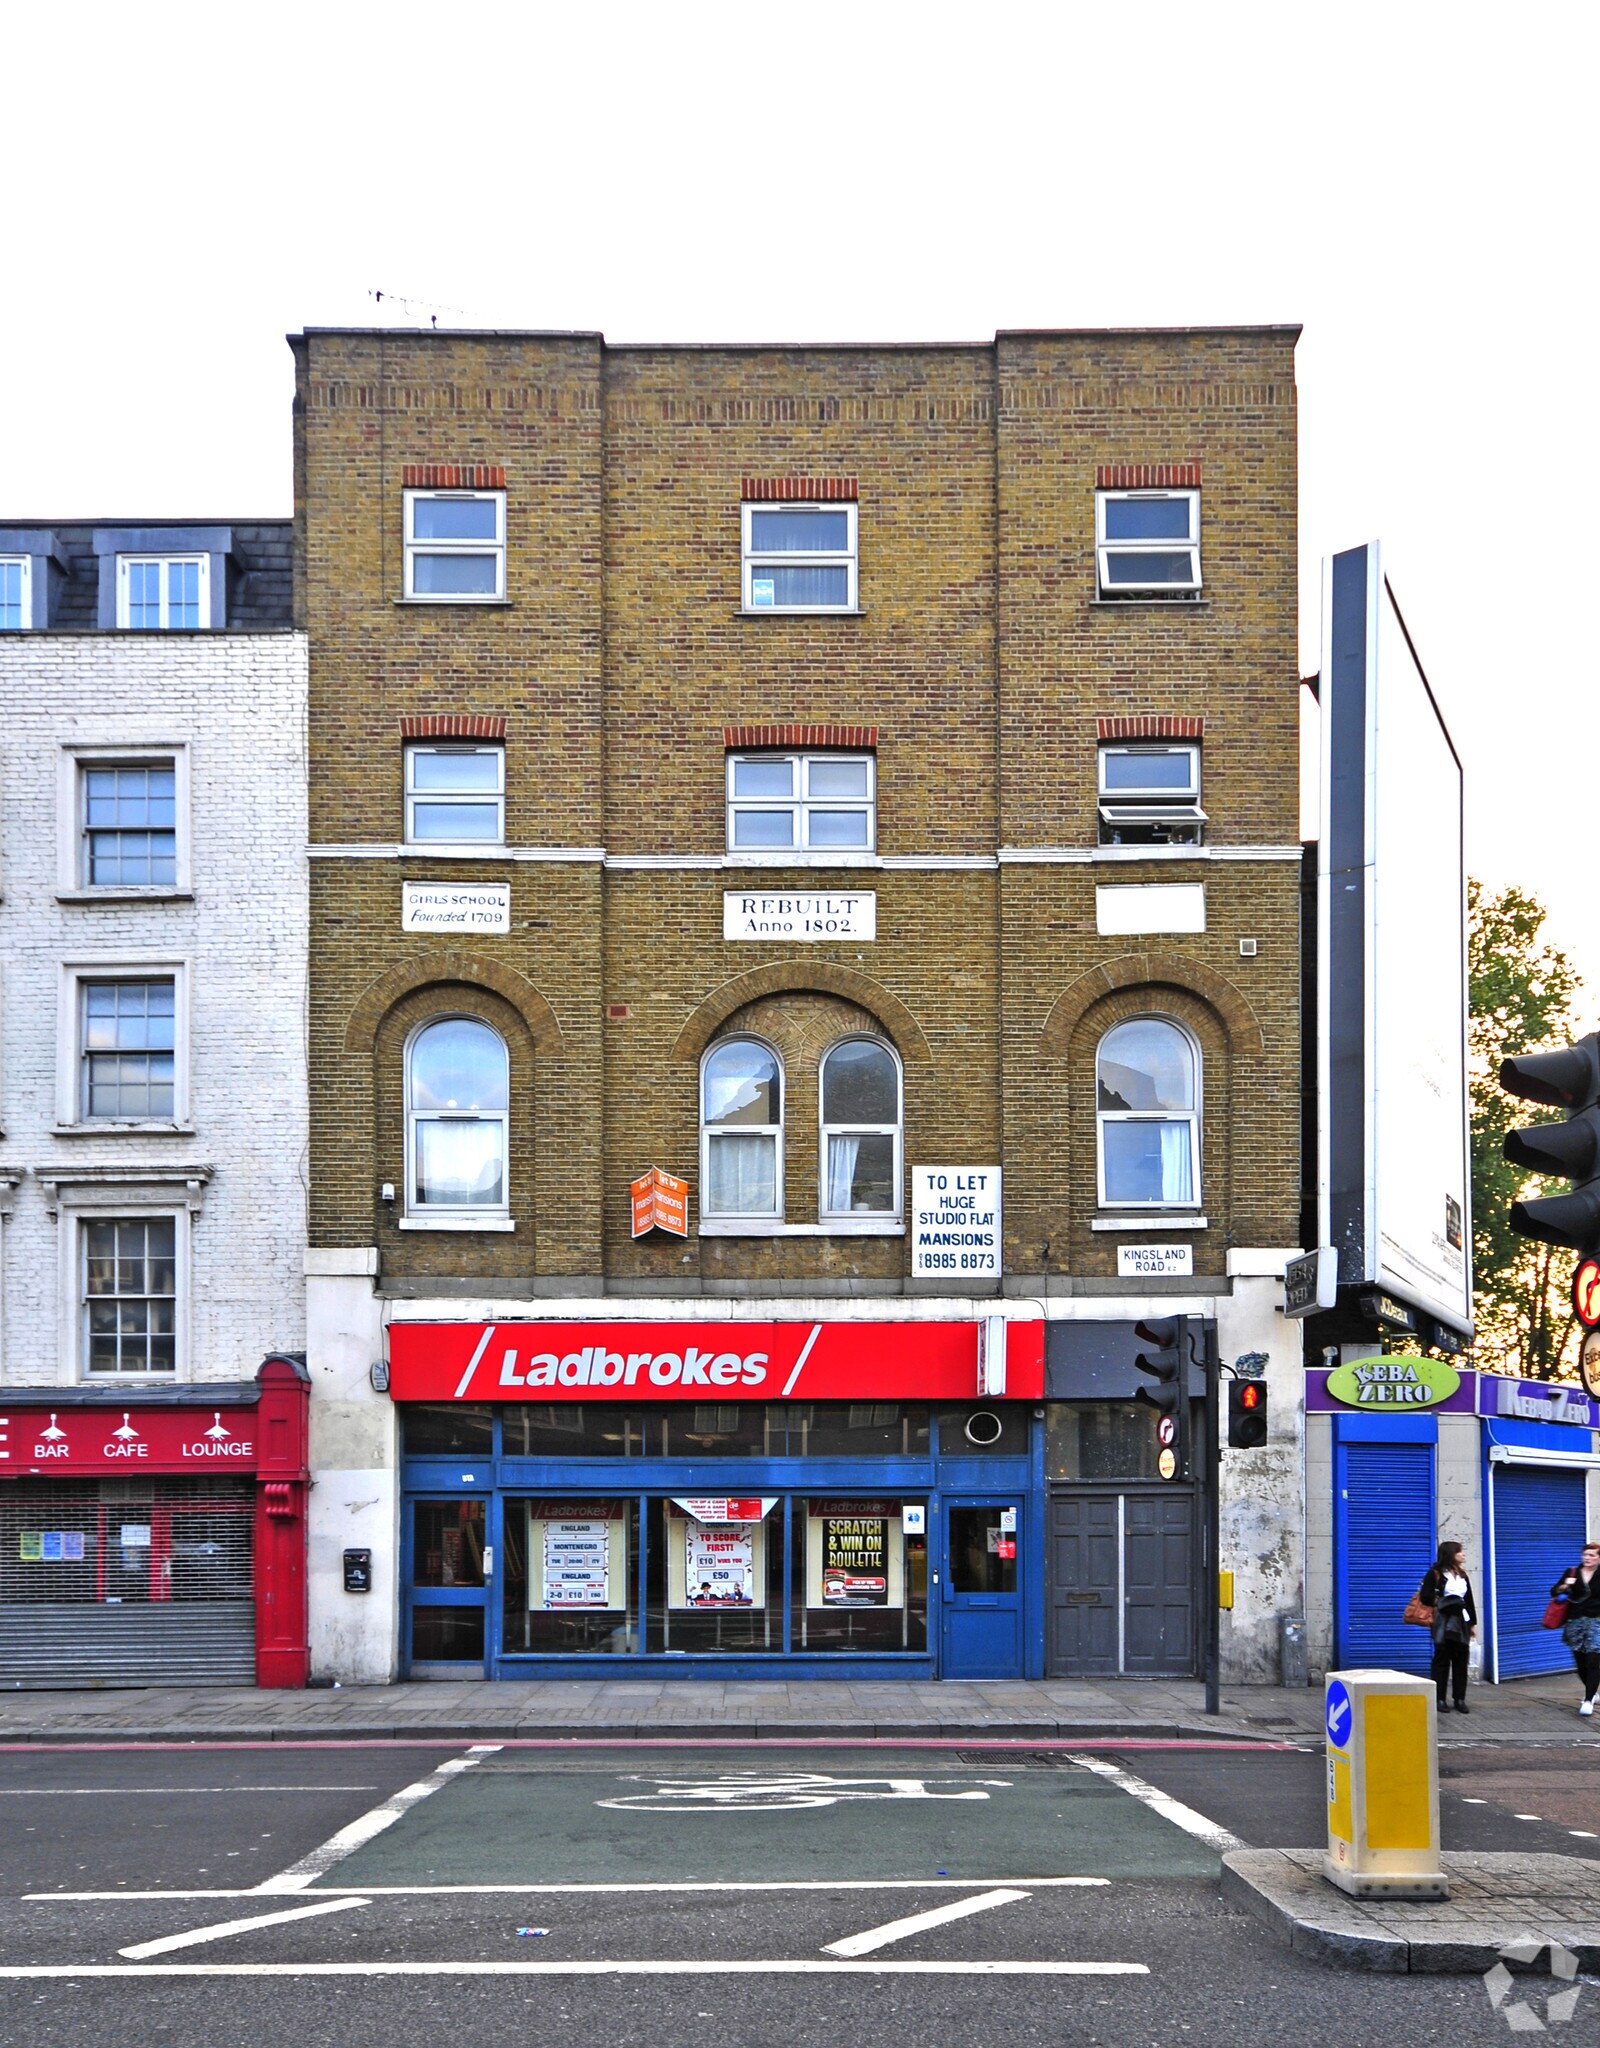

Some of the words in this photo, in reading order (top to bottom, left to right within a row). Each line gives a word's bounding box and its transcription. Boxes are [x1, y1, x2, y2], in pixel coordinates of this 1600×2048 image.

[409, 894, 448, 904] GIRLS
[451, 896, 505, 906] SCHOOL
[742, 898, 859, 914] REBUILT
[471, 912, 503, 922] 1709
[745, 919, 793, 932] Anno
[927, 1175, 947, 1190] TO
[957, 1175, 987, 1190] LET
[940, 1196, 975, 1209] HUGE
[919, 1212, 966, 1225] STUDIO
[970, 1213, 994, 1225] FLAT
[919, 1233, 994, 1246] MANSIONS
[925, 1253, 956, 1268] 8985
[961, 1253, 994, 1269] 8873
[1124, 1250, 1186, 1260] KINGSLAND
[1136, 1261, 1165, 1271] ROAD
[499, 1347, 769, 1387] Ladbrokes
[1353, 1364, 1418, 1384] KEBA
[1359, 1385, 1432, 1402] ZERO
[34, 1445, 69, 1458] BAR
[103, 1444, 148, 1457] CAFE
[182, 1443, 253, 1456] LOUNGE
[544, 1505, 608, 1516] Ladbrokes
[824, 1502, 886, 1513] Ladbrokes
[829, 1520, 882, 1535] SCRATCH
[700, 1534, 712, 1542] TO
[713, 1534, 741, 1542] SCORE
[828, 1536, 837, 1550] &
[840, 1536, 862, 1550] WIN
[866, 1536, 882, 1550] ON
[707, 1544, 734, 1552] FIRST!
[828, 1551, 882, 1567] ROULETTE
[713, 1572, 729, 1580] £50
